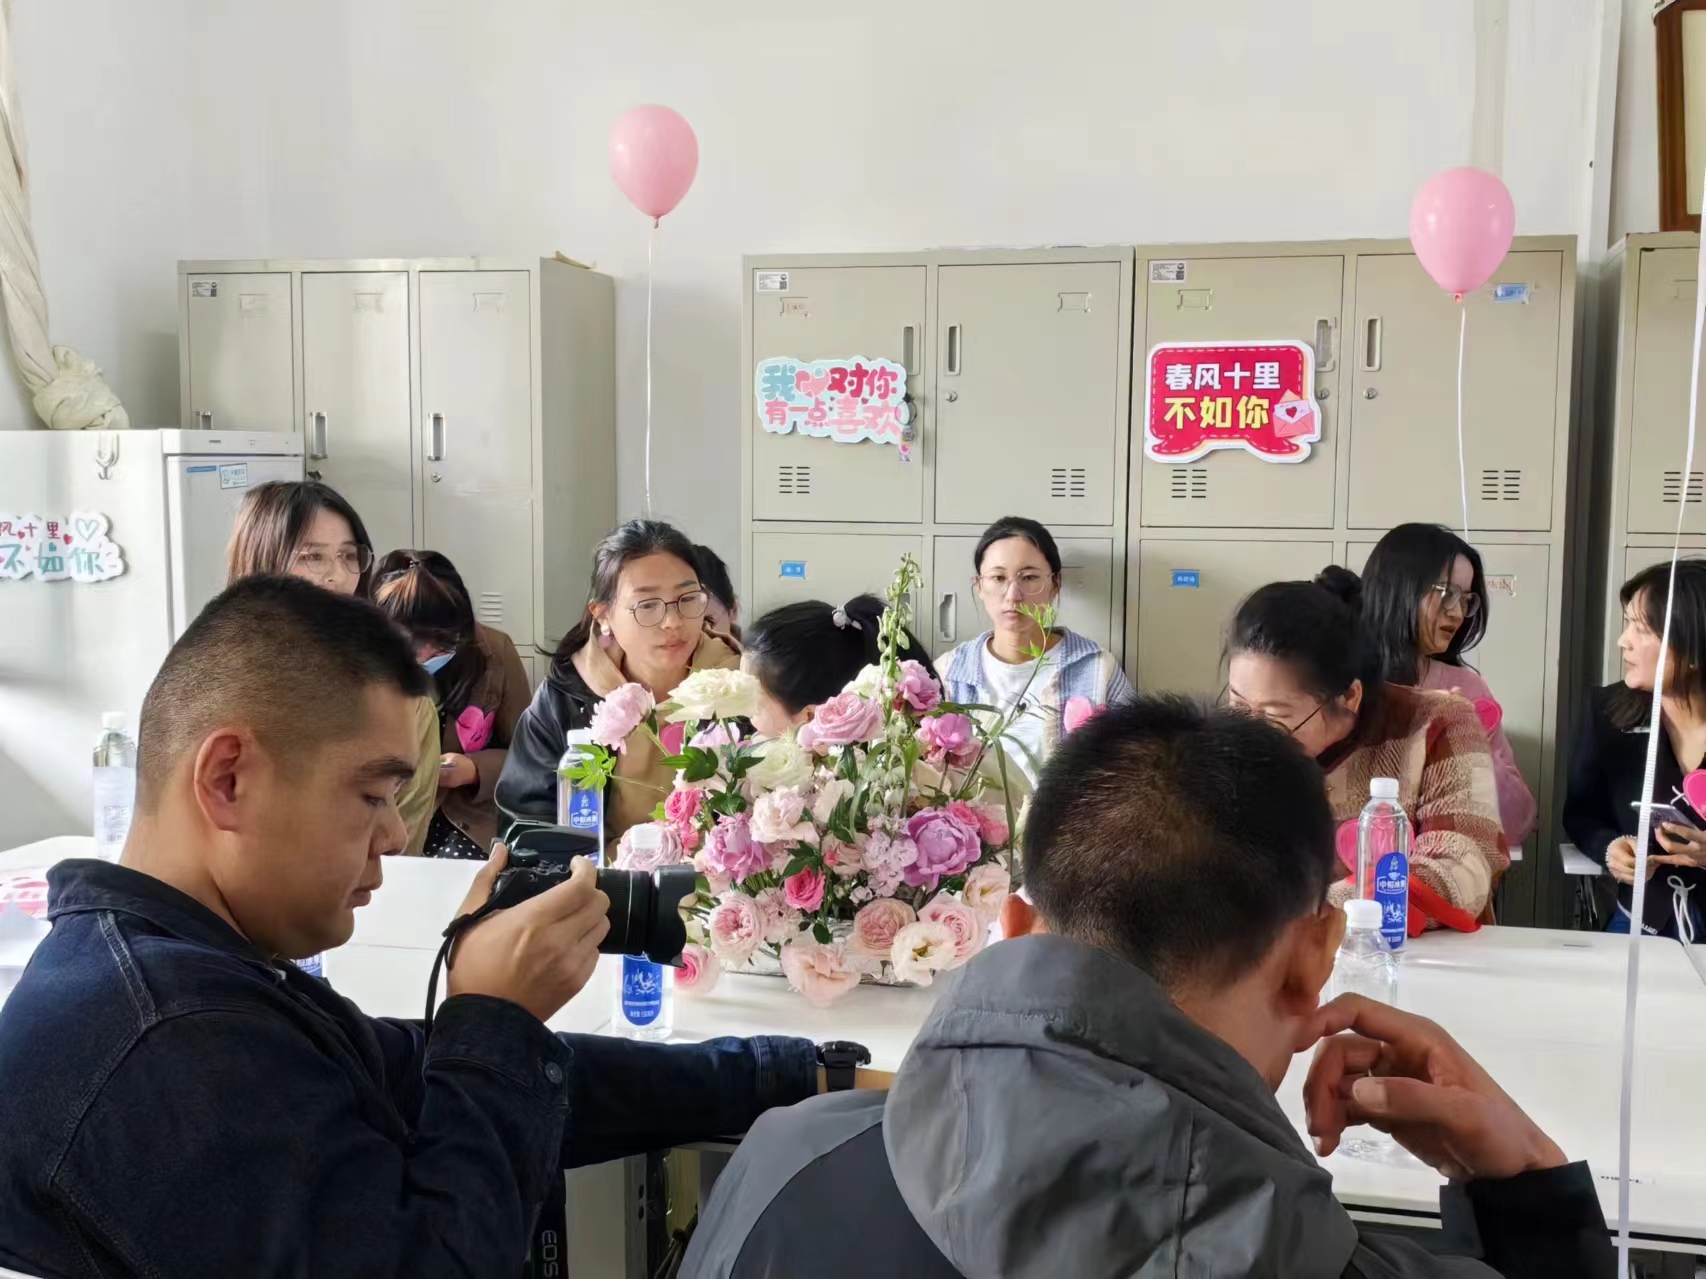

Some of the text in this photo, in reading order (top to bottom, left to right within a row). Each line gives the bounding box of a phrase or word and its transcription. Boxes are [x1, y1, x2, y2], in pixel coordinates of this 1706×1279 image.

[1165, 362, 1281, 390] 春风十里
[1163, 395, 1270, 430] 不如你
[541, 1229, 559, 1278] EOS
